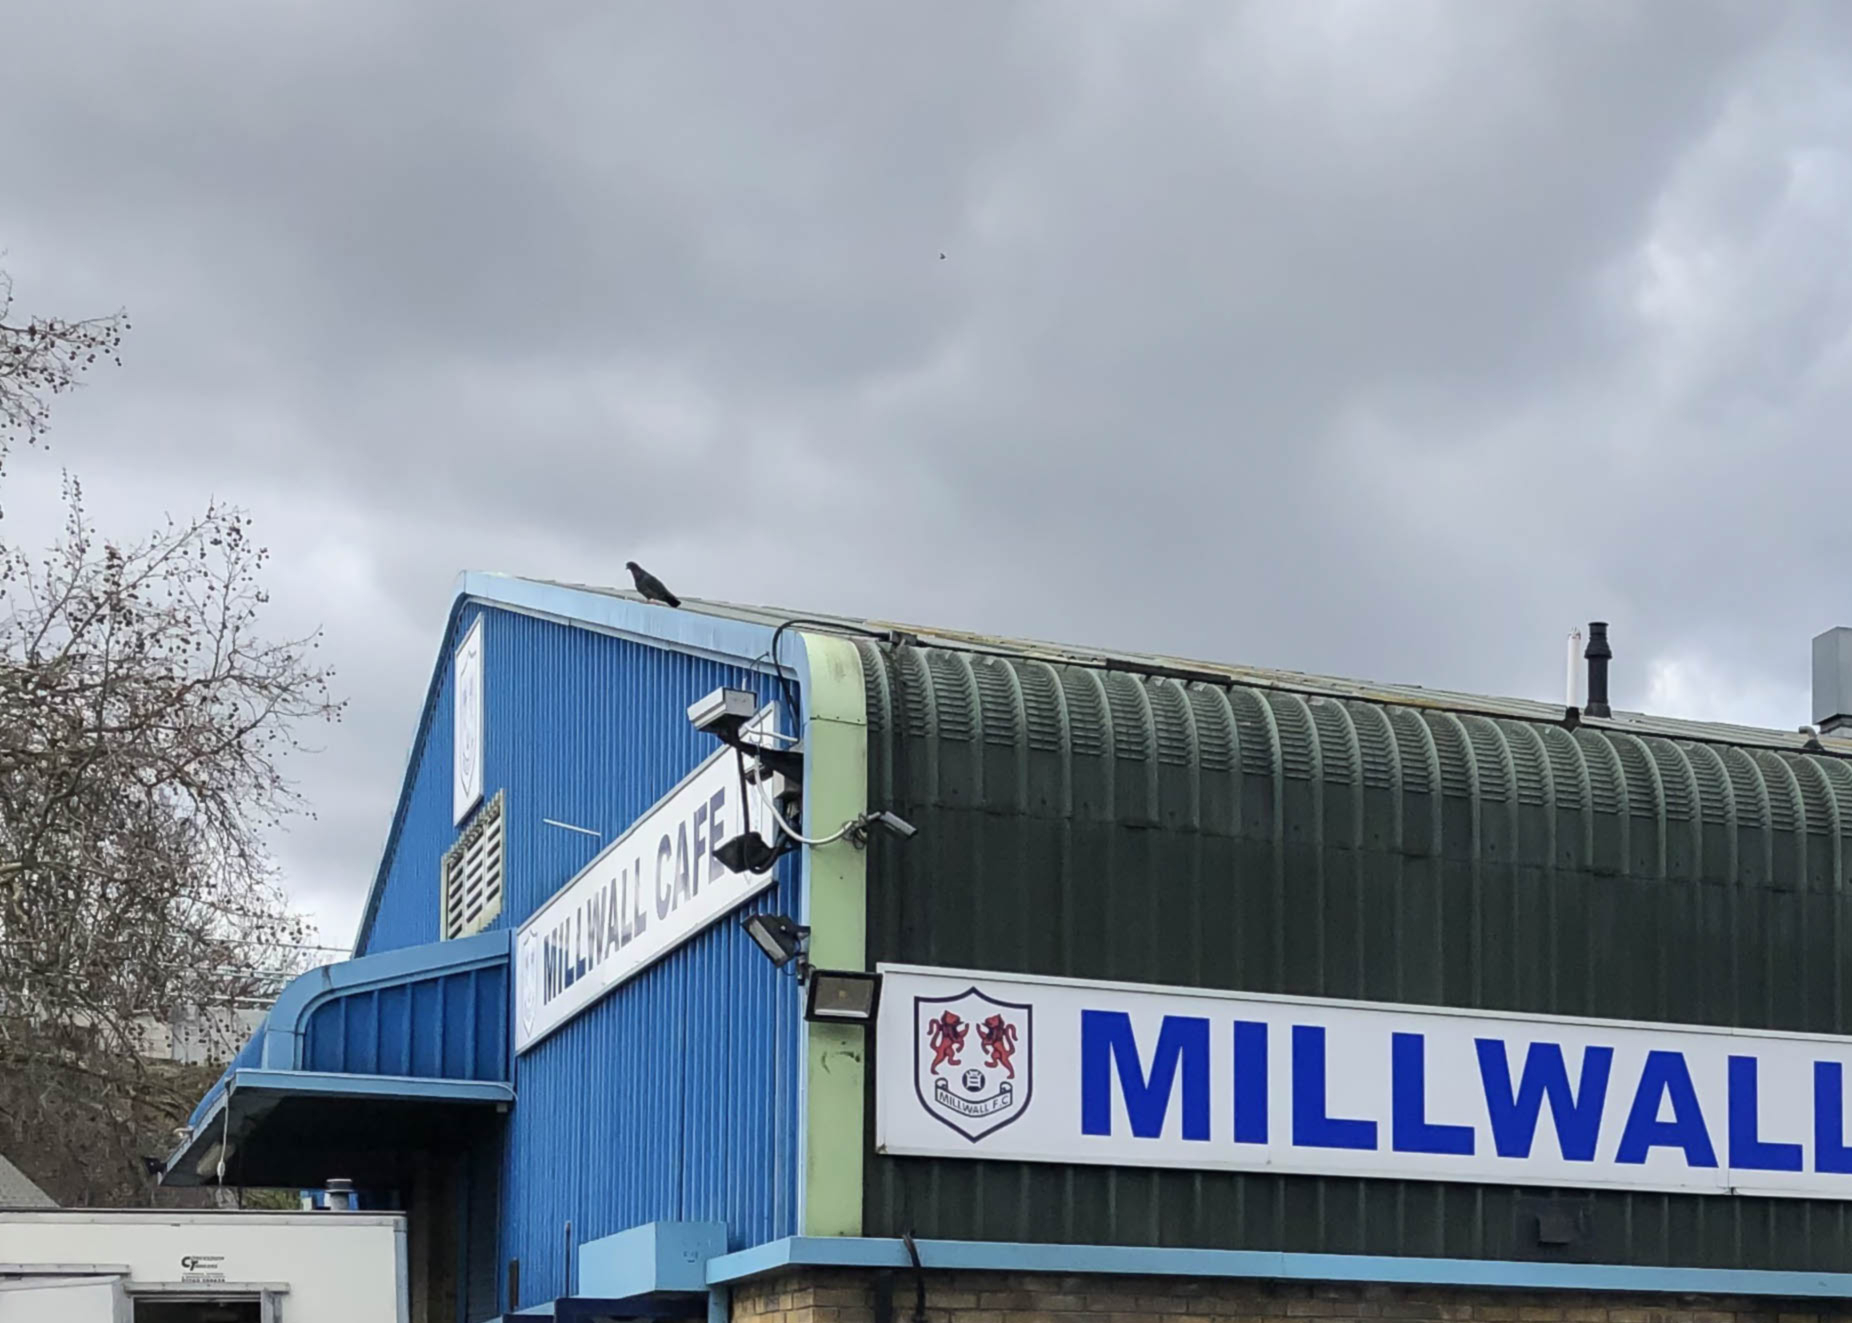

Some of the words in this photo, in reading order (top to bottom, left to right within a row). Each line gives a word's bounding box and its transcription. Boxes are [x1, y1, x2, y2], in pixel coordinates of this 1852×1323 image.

[543, 857, 647, 1006] MILLWALL
[655, 786, 726, 920] CAFE
[939, 1091, 989, 1114] MILLWALL
